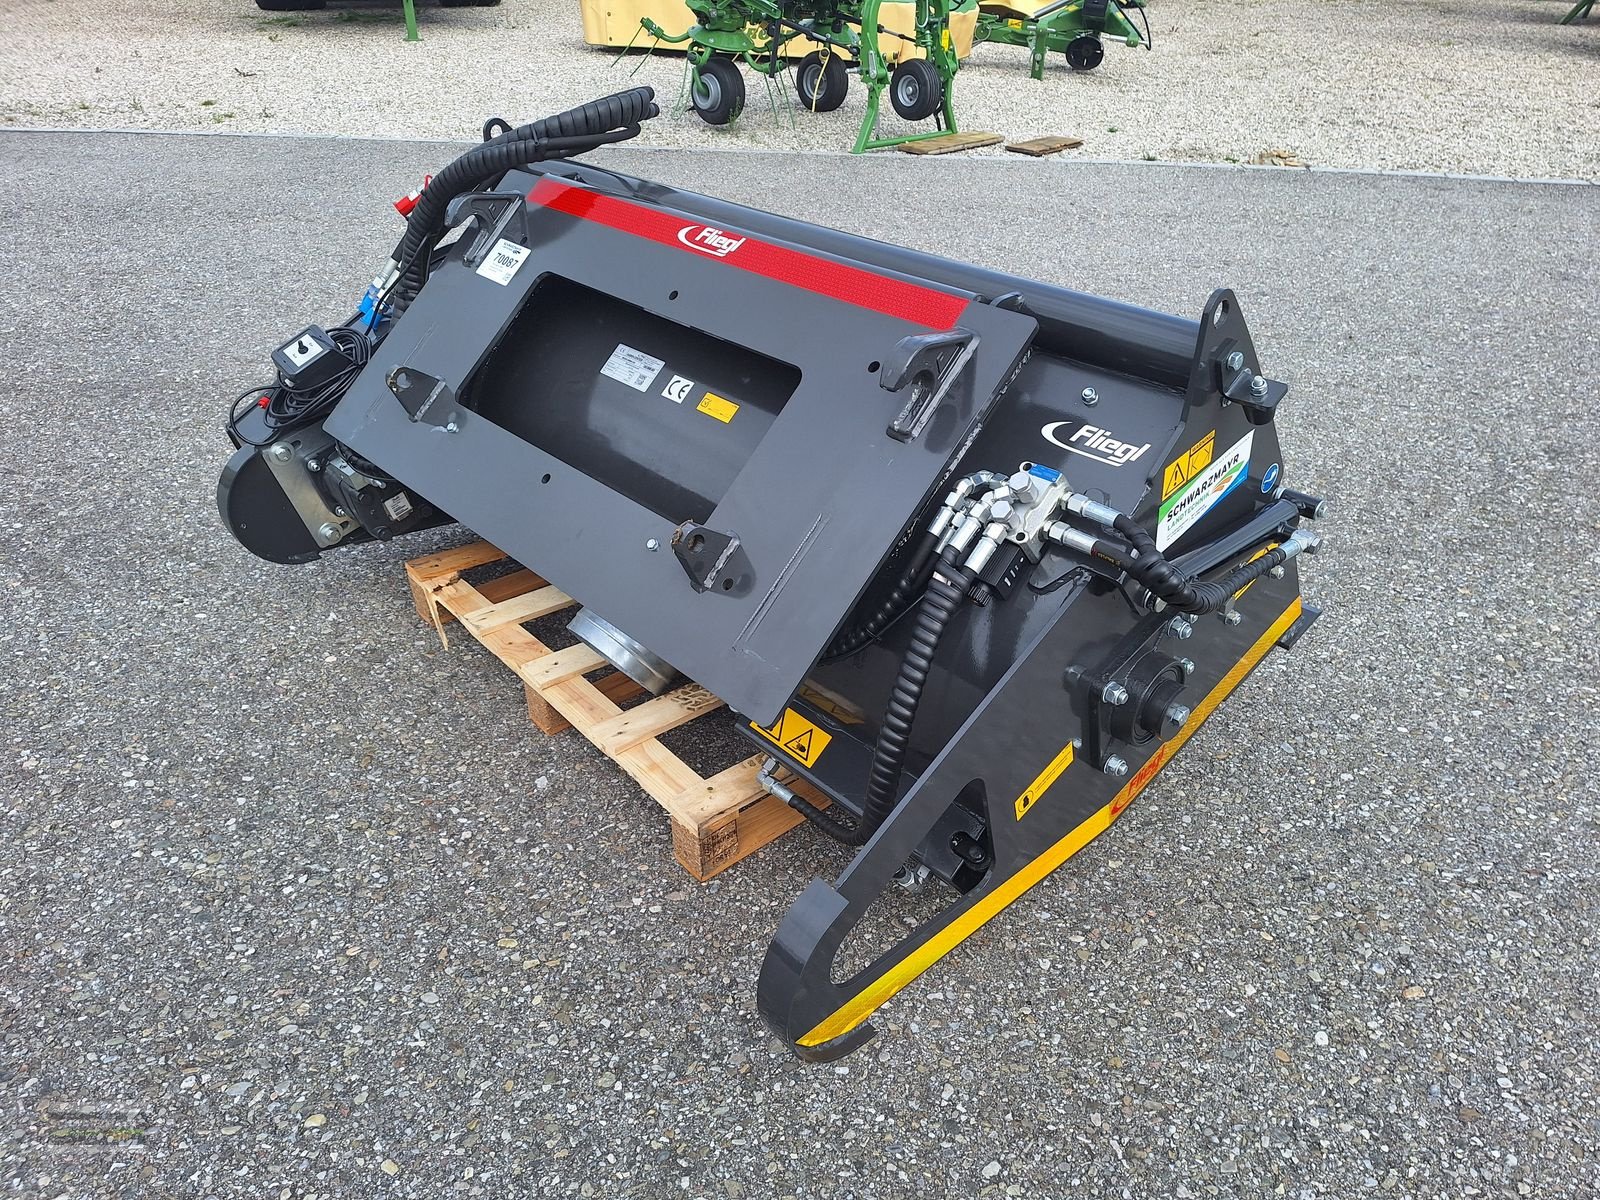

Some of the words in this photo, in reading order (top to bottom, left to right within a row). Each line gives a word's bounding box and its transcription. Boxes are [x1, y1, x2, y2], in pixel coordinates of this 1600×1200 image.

[694, 226, 747, 255] Fliegl
[493, 252, 519, 269] 70087
[667, 379, 690, 400] CE
[1068, 423, 1152, 464] Fliegl
[1166, 453, 1240, 523] SCHWARZMAYR
[1166, 491, 1212, 532] LANDTECHNIK
